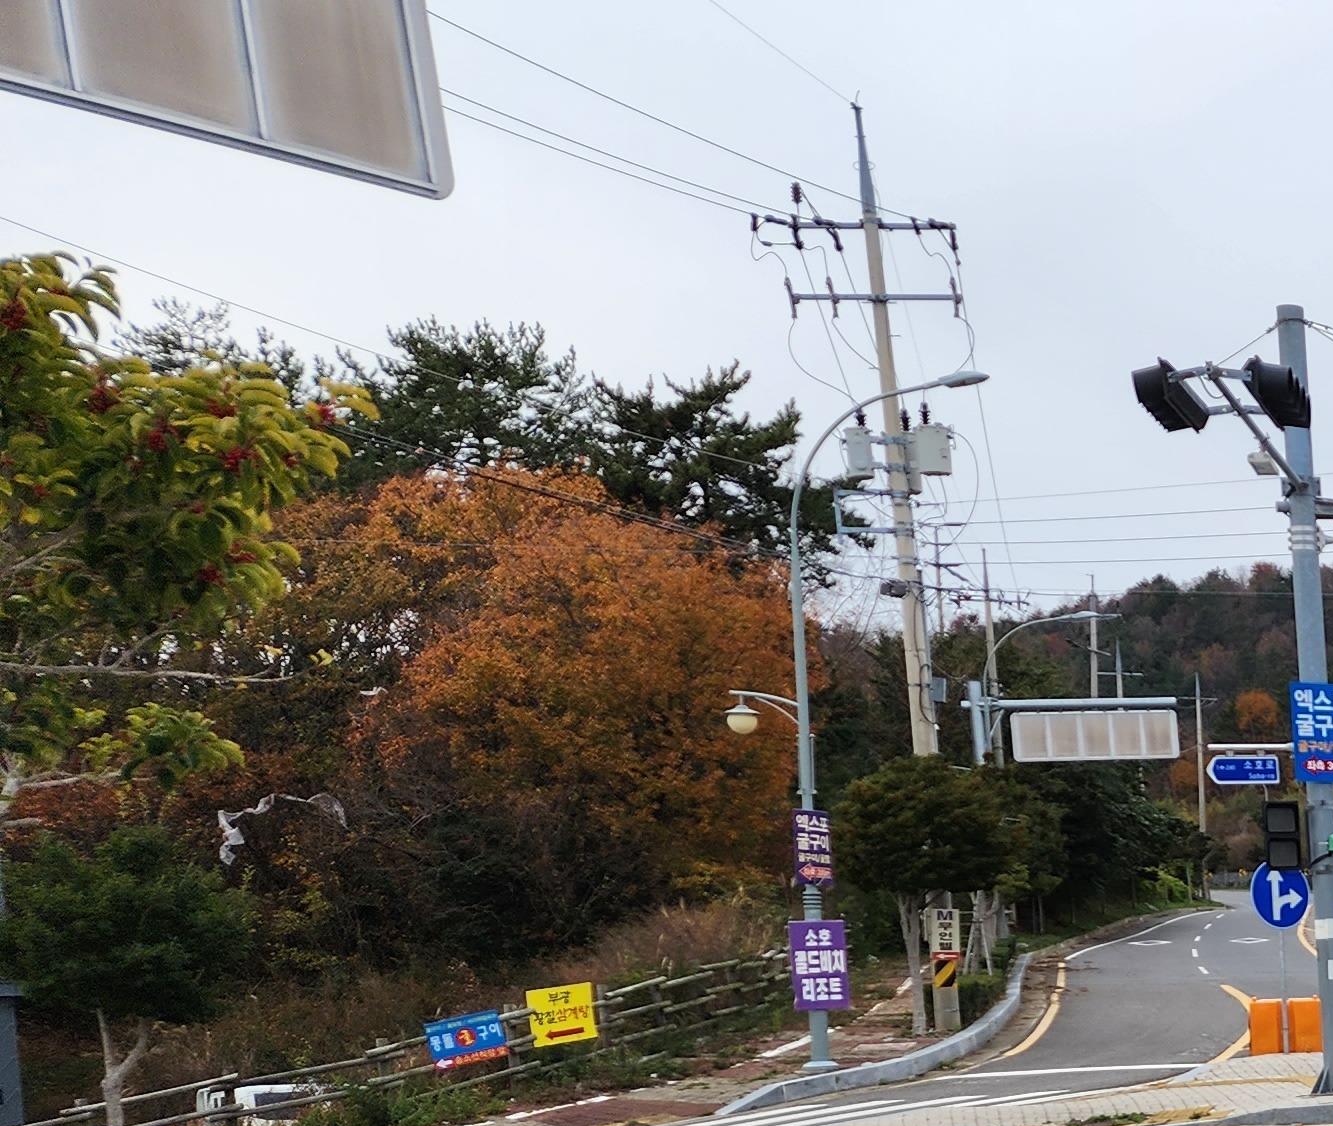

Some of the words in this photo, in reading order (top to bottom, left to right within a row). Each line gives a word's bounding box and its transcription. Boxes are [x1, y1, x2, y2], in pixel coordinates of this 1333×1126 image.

[1243, 760, 1275, 770] 소호로
[795, 814, 830, 833] 엑스포
[796, 832, 831, 852] 굴구이
[804, 928, 833, 947] 소호
[794, 949, 847, 975] 골드비치
[801, 977, 844, 1002] 리조트
